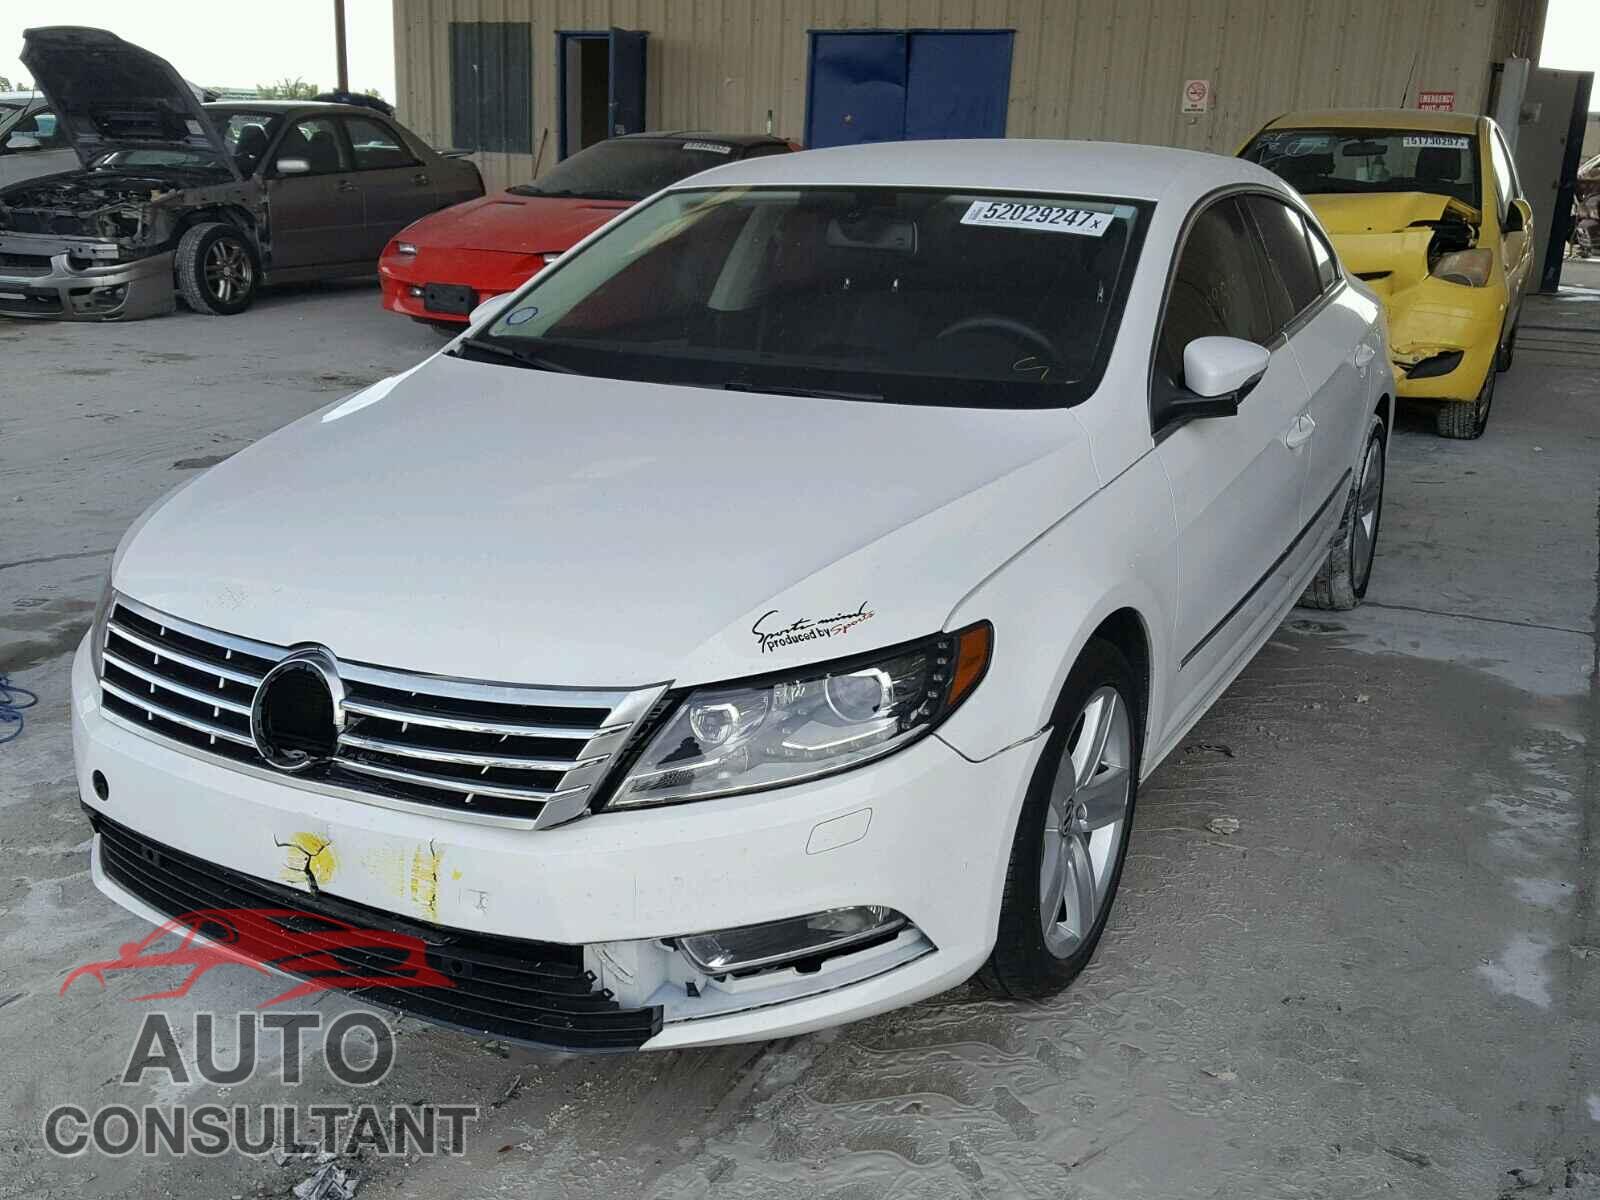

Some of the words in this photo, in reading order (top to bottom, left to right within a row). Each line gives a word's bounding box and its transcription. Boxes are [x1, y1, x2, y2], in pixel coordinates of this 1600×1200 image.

[983, 203, 1094, 226] 52029247
[766, 628, 817, 652] produced
[816, 627, 832, 637] by
